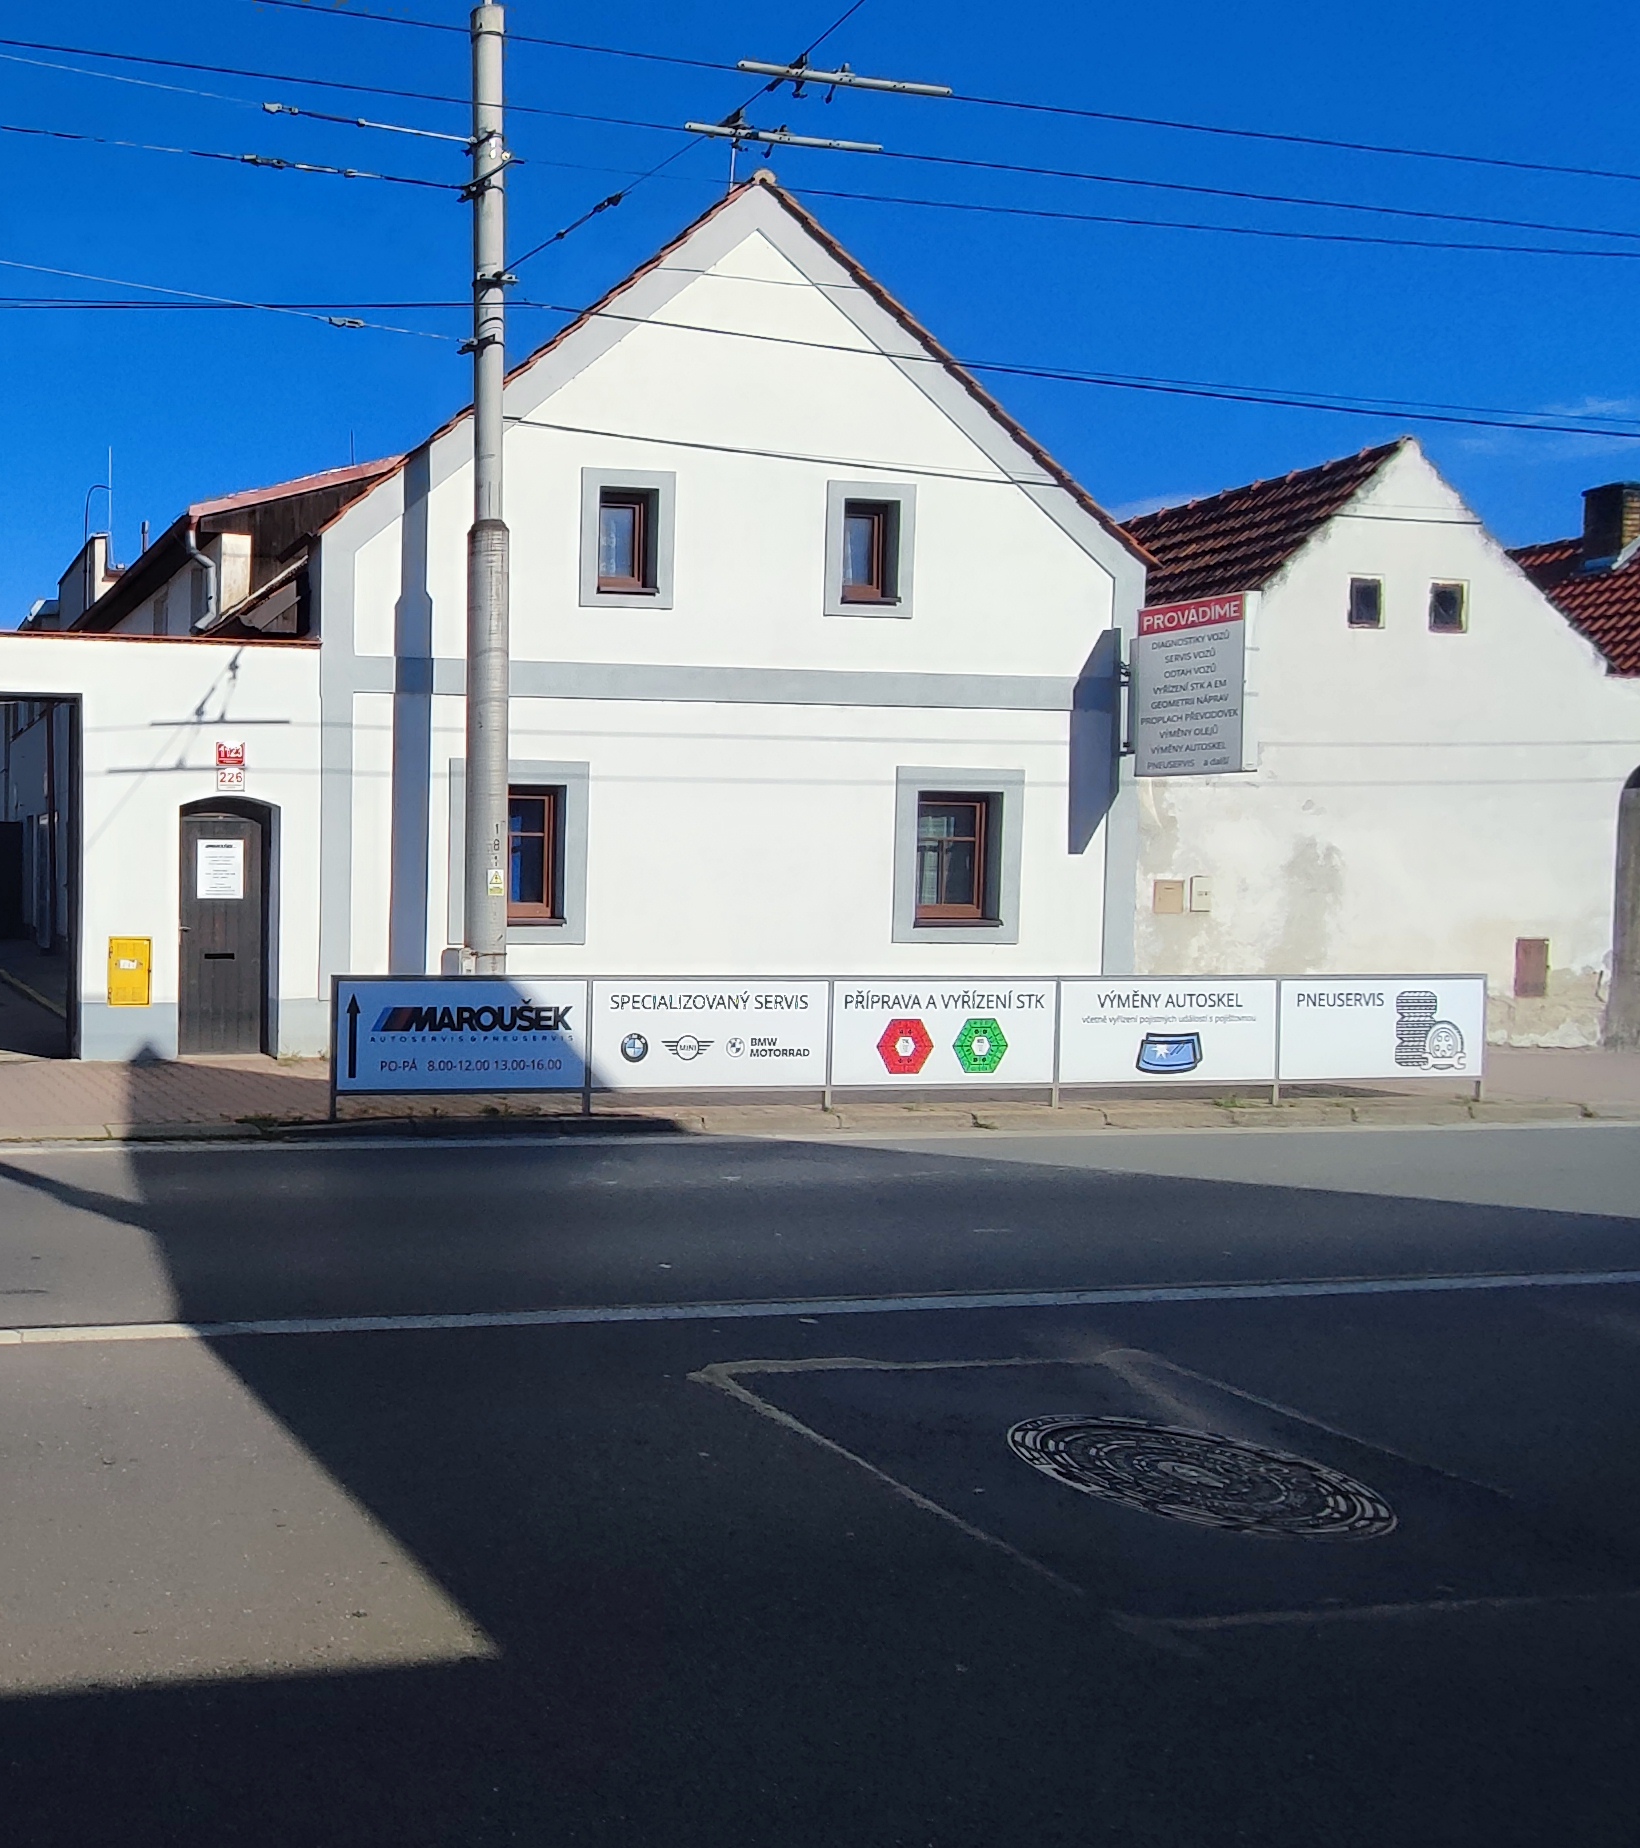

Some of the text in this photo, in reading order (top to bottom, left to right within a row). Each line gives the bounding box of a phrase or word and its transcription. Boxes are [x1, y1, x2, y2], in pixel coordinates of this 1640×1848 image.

[1143, 601, 1241, 632] PROVÁDÍME
[1151, 635, 1206, 650] DIAGNOSTIKY
[1164, 652, 1192, 664] SERVIS
[1163, 670, 1192, 679] ODTAH
[220, 771, 243, 783] 226
[610, 990, 809, 1010] SPECIALIZOVANÝ SERVIS
[844, 989, 1046, 1010] PŘÍPRAVA A VYŘÍZENÍ STK
[1097, 989, 1244, 1009] VÝMĚNY AUTOSKEL
[1296, 992, 1385, 1008] PNEUSERVIS
[407, 998, 573, 1032] MAROUŠEK
[751, 1037, 778, 1047] BMW
[750, 1048, 810, 1058] MOTORRAD
[427, 1059, 490, 1072] 8.00-12.00
[494, 1059, 562, 1071] 13.00-16.00
